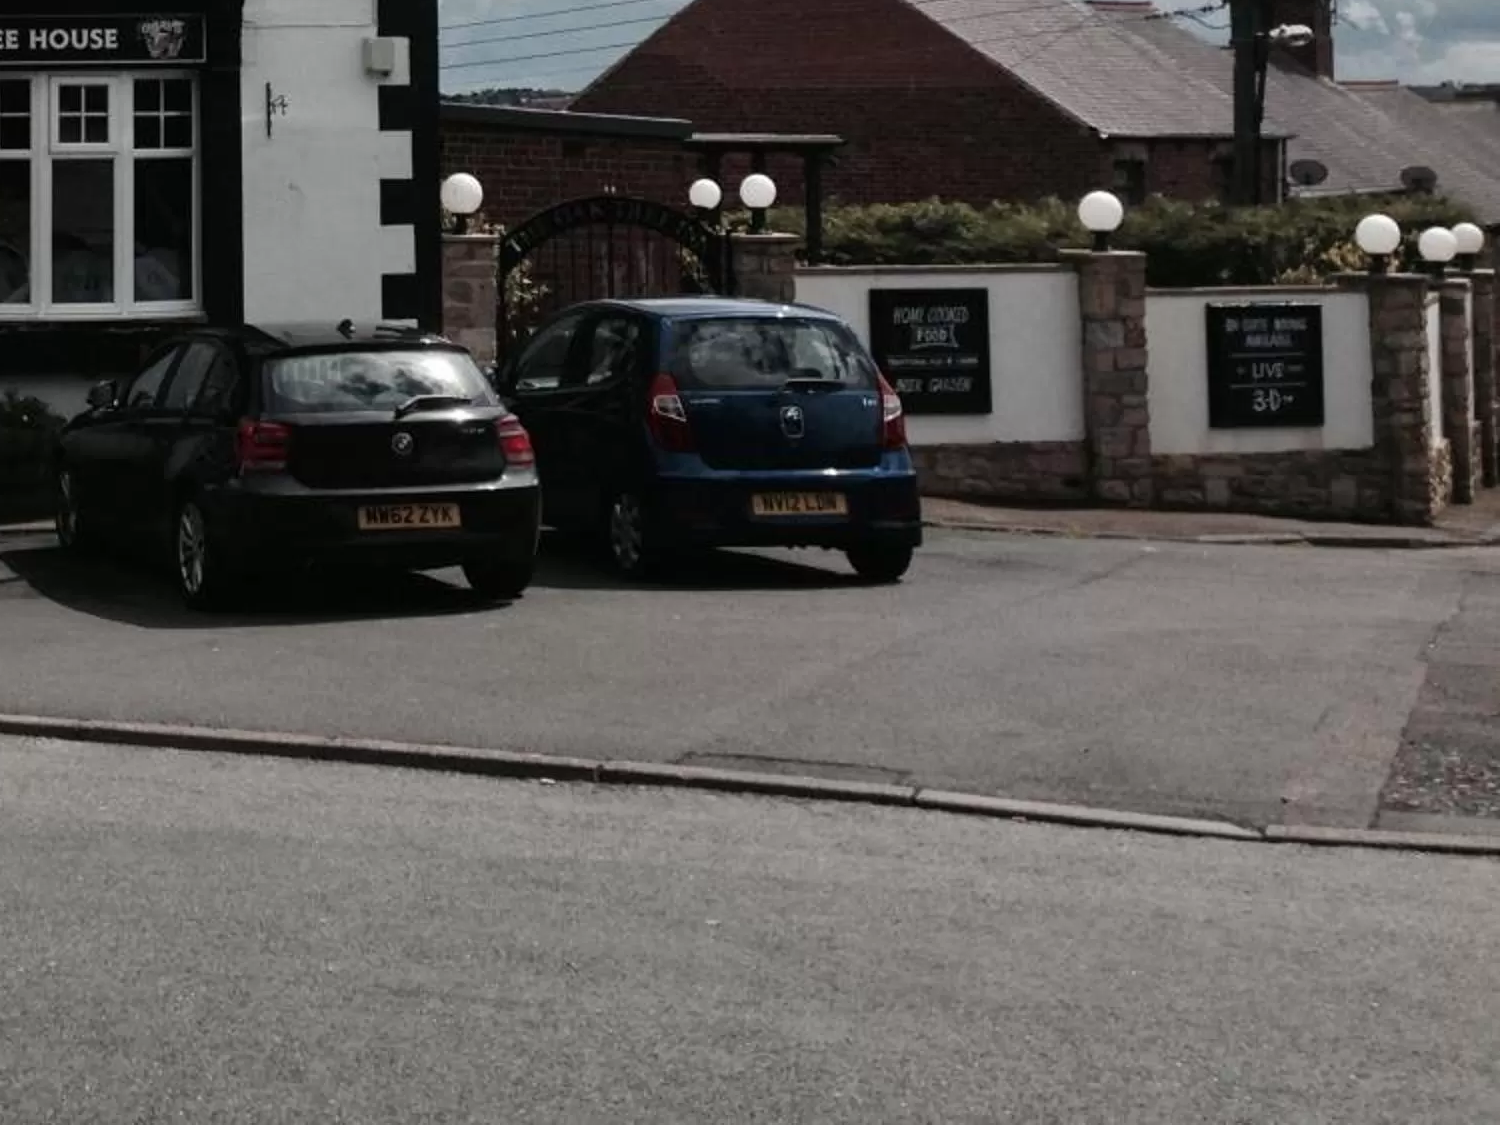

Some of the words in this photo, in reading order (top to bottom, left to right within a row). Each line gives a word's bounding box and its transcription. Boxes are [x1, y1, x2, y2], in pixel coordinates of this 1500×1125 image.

[29, 28, 119, 50] HOUSE
[916, 329, 948, 342] FOOD
[1251, 362, 1284, 379] LIVE
